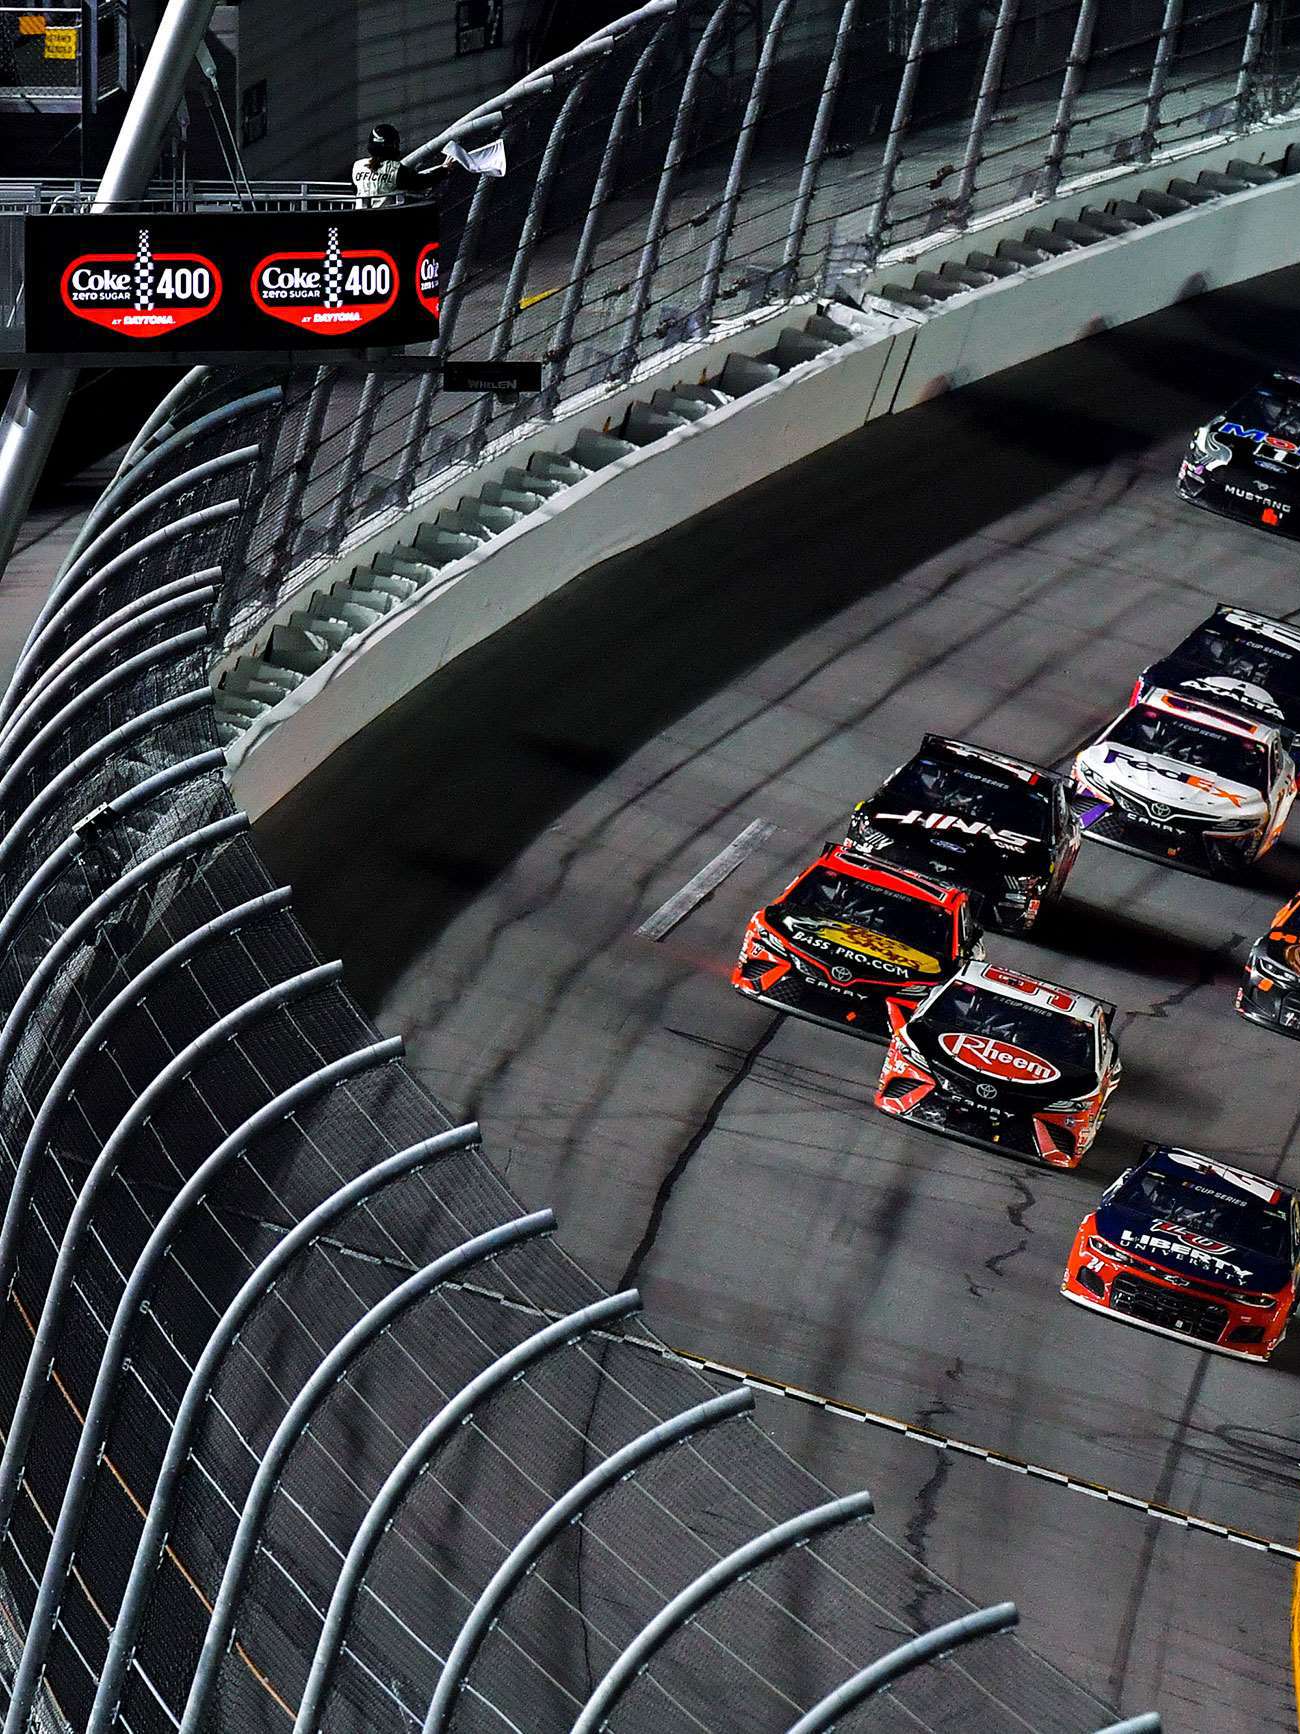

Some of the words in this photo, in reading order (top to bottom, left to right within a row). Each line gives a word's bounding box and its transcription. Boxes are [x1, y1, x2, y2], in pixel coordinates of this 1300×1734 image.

[355, 171, 392, 183] OFFICIAL
[72, 269, 131, 291] Coke
[156, 268, 210, 299] 400
[262, 267, 320, 289] Coke
[345, 264, 390, 296] 400
[72, 292, 98, 301] zero
[99, 292, 131, 300] SUGAR
[262, 290, 287, 298] zero
[289, 290, 320, 298] SUGAR
[123, 316, 175, 325] DAYTONA
[313, 312, 361, 323] DAYTONA
[1224, 484, 1291, 513] MUSTANG
[1180, 678, 1285, 720] AXALTA
[1104, 749, 1247, 809] FedEx
[1127, 812, 1186, 835] CAMRY
[791, 930, 831, 950] BASS
[835, 946, 910, 979] PRO.COM
[805, 976, 869, 1001] CAMRY
[952, 1033, 1052, 1080] Rheem
[951, 1095, 1016, 1119] CAMRY
[1194, 1185, 1215, 1196] CUP
[1214, 1191, 1249, 1208] SERIES
[1119, 1239, 1247, 1286] UNIVERSITY
[1121, 1229, 1254, 1280] LIBERTY
